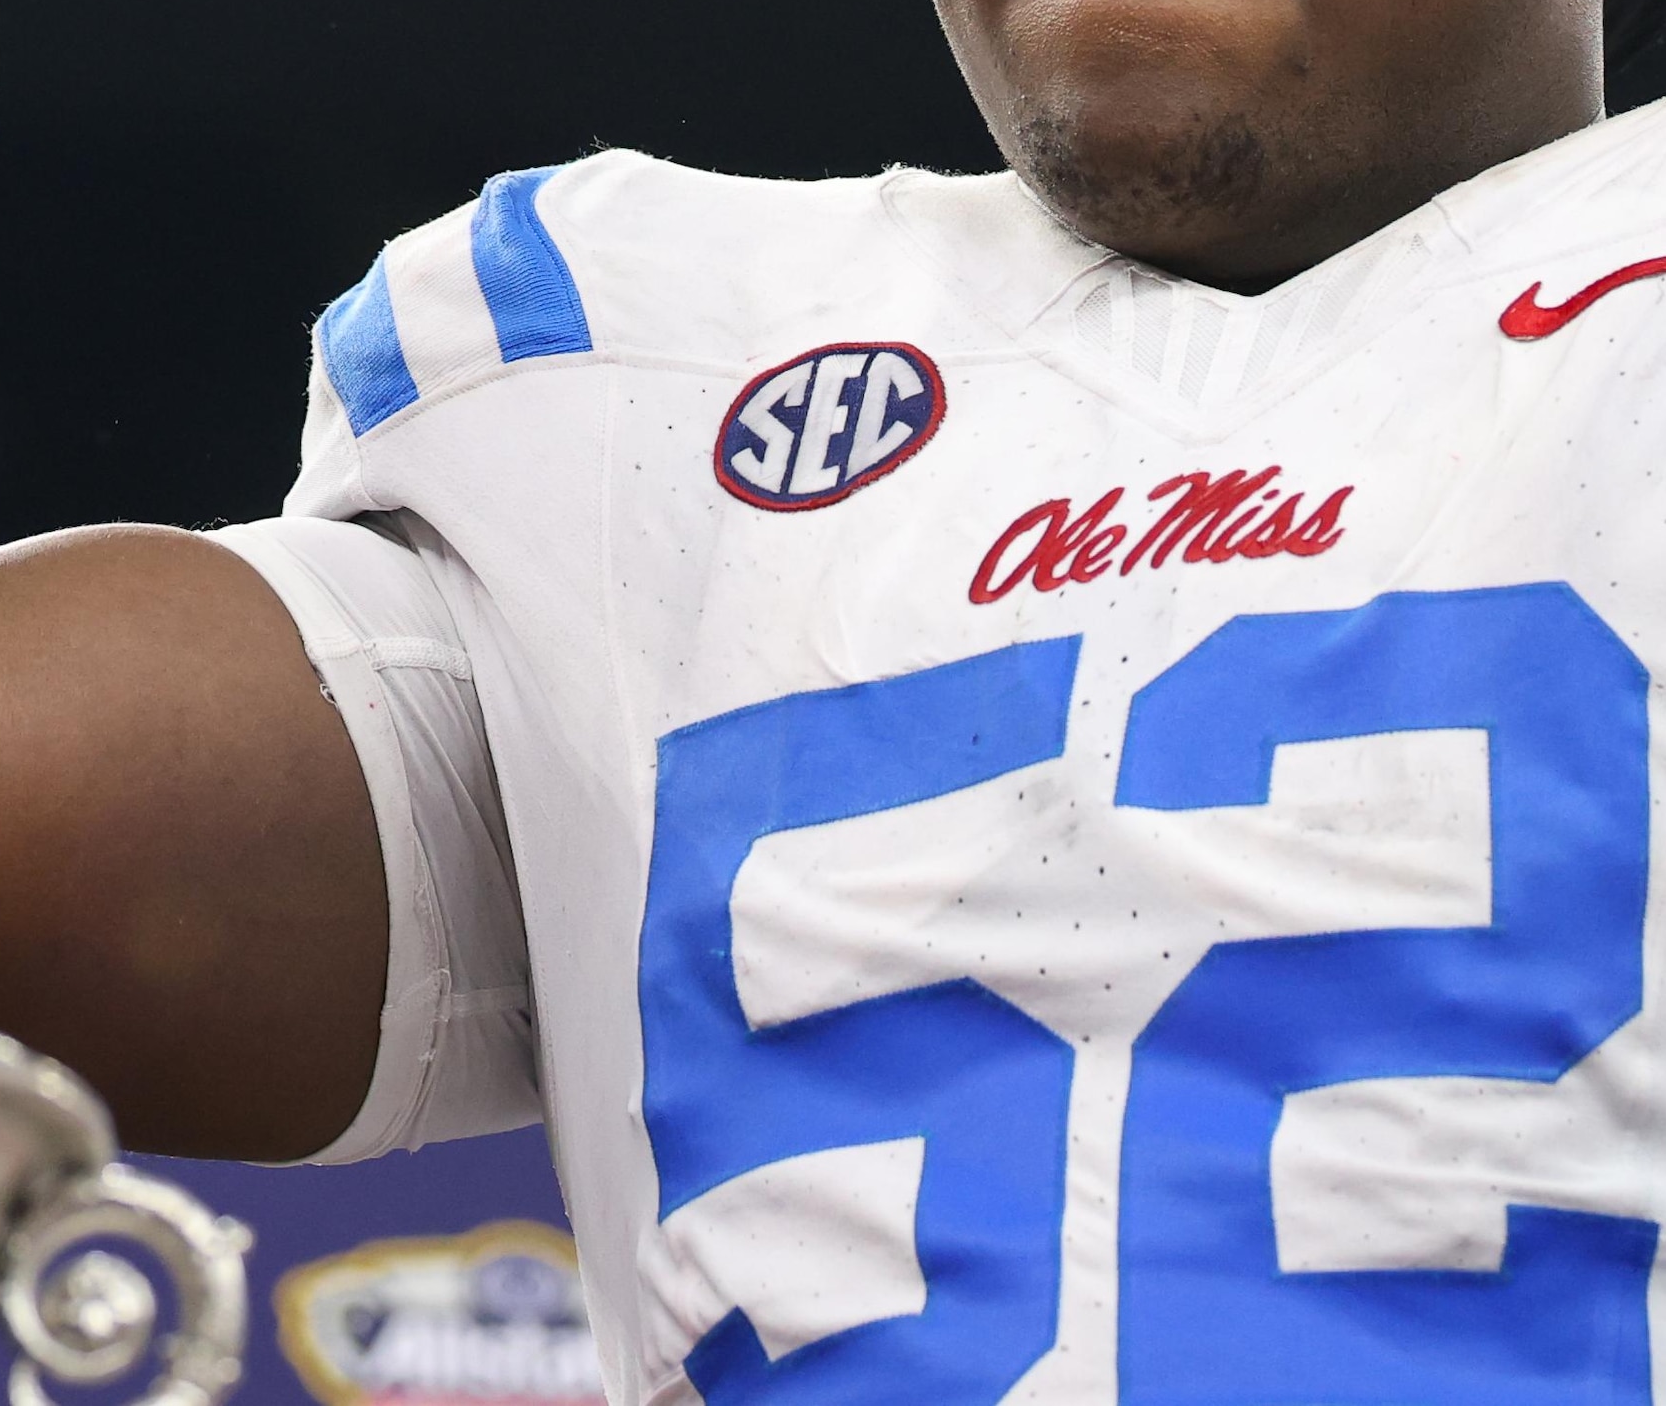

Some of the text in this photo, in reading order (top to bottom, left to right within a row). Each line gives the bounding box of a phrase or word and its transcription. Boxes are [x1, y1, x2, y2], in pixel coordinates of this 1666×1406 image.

[730, 351, 926, 495] SEC
[968, 465, 1355, 605] Ole Miss
[637, 580, 1660, 1406] 52
